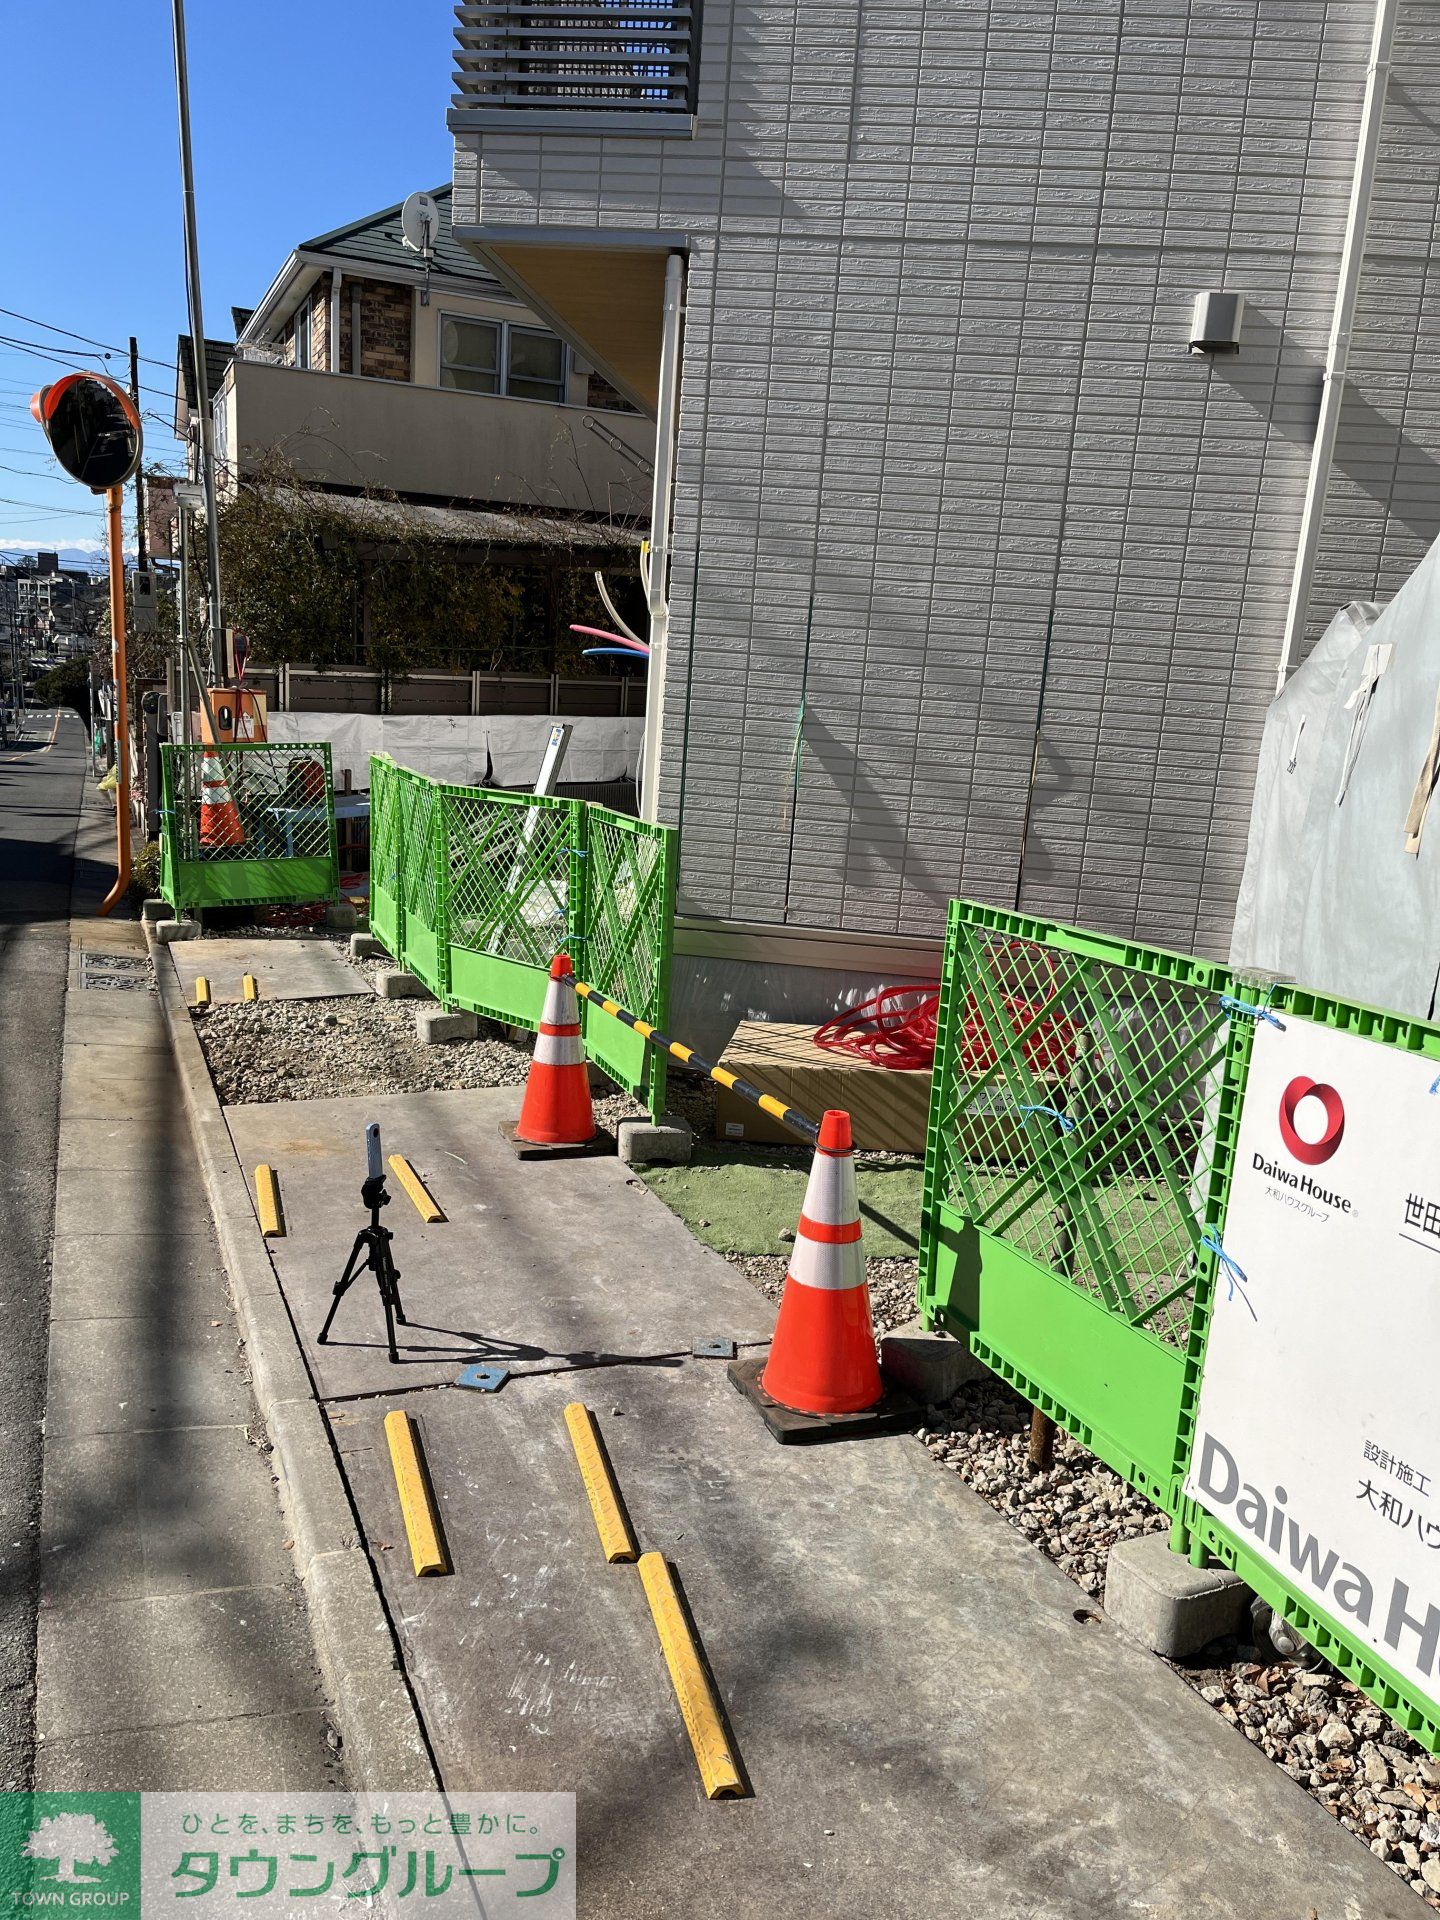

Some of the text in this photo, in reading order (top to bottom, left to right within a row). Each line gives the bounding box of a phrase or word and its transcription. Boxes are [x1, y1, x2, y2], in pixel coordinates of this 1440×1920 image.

[1252, 1152, 1352, 1214] Daiwa House
[1363, 1439, 1432, 1498] 設計施工
[1198, 1432, 1440, 1678] Daiwa H
